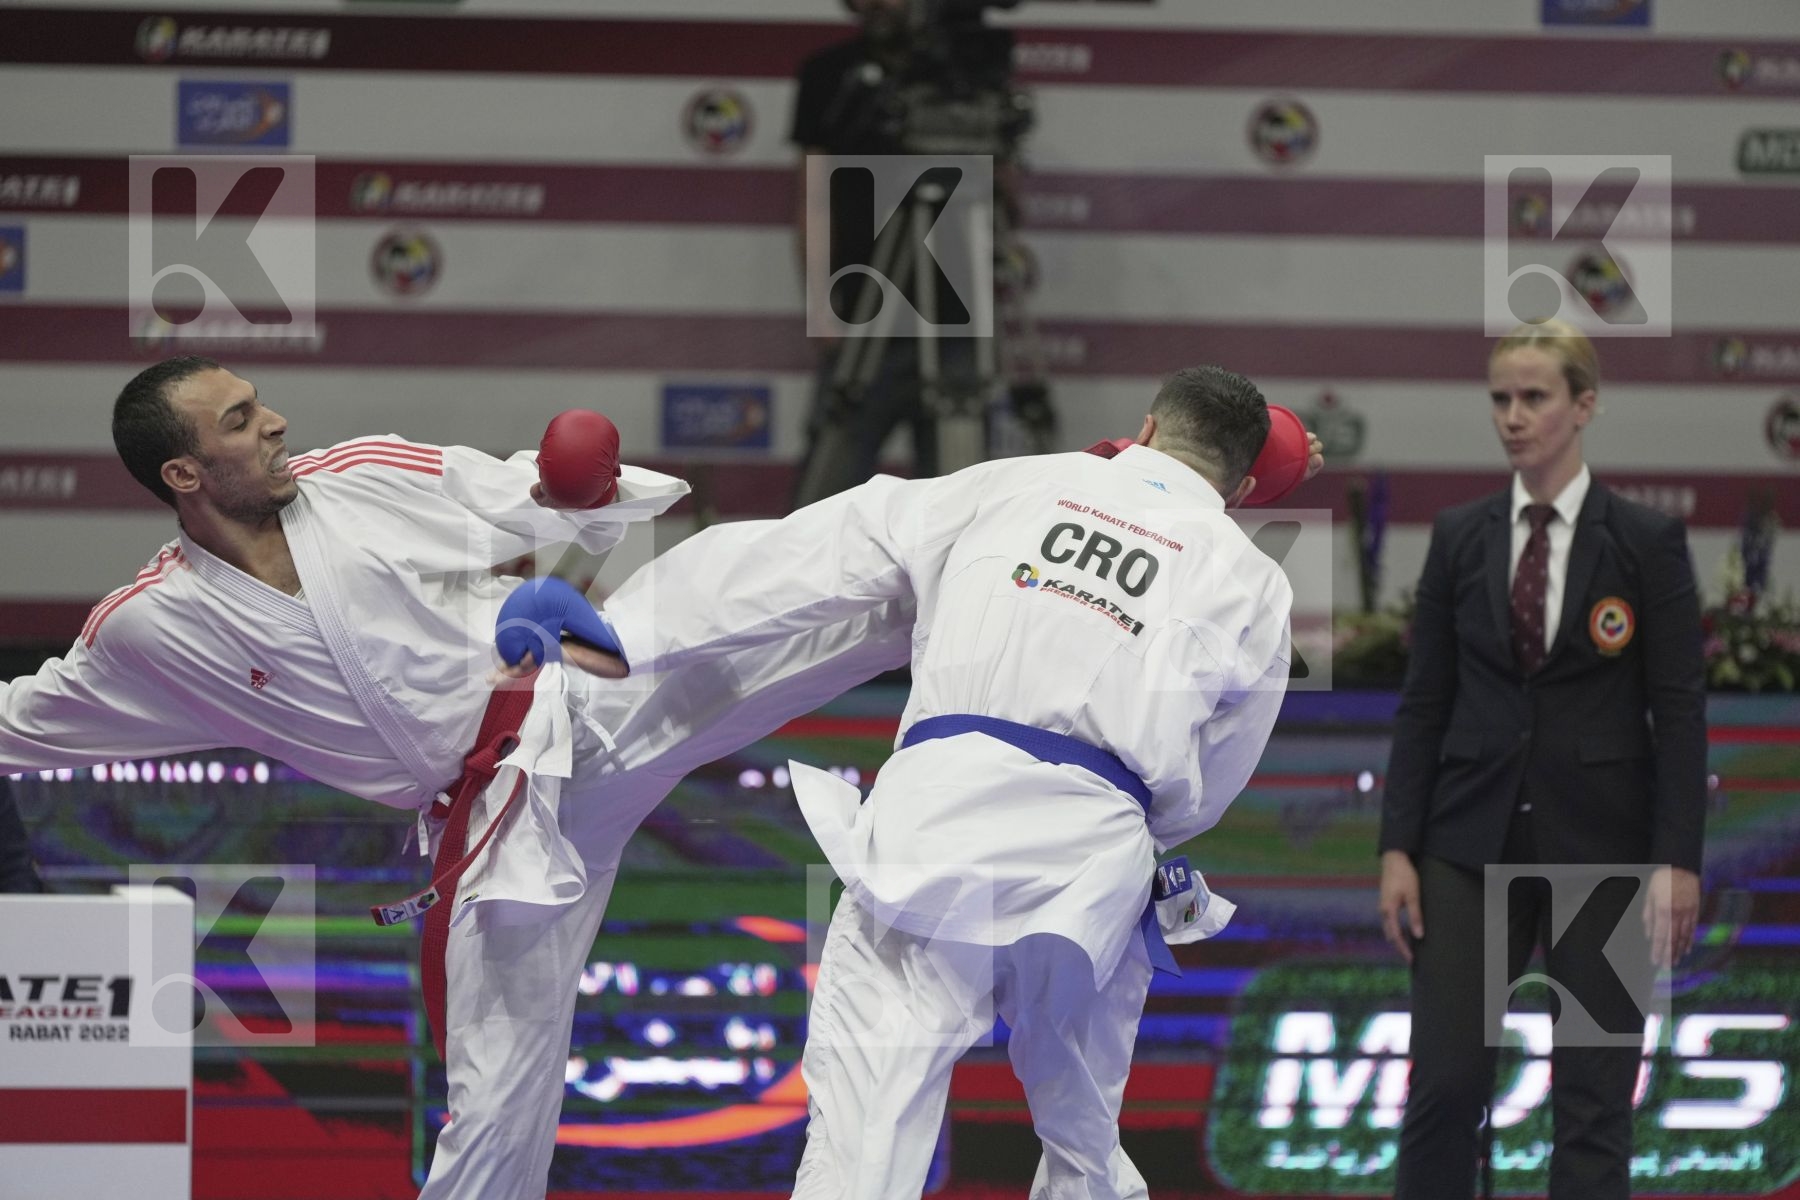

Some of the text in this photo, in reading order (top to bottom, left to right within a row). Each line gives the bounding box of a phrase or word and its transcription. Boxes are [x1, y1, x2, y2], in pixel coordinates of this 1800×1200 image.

[1057, 499, 1184, 553] WORLD KARATE FEDERATION
[1040, 522, 1160, 598] CRO
[1039, 587, 1131, 633] PREMIER LEAGUE
[1042, 578, 1145, 637] KARATE1
[9, 1024, 130, 1042] RABAT 2022
